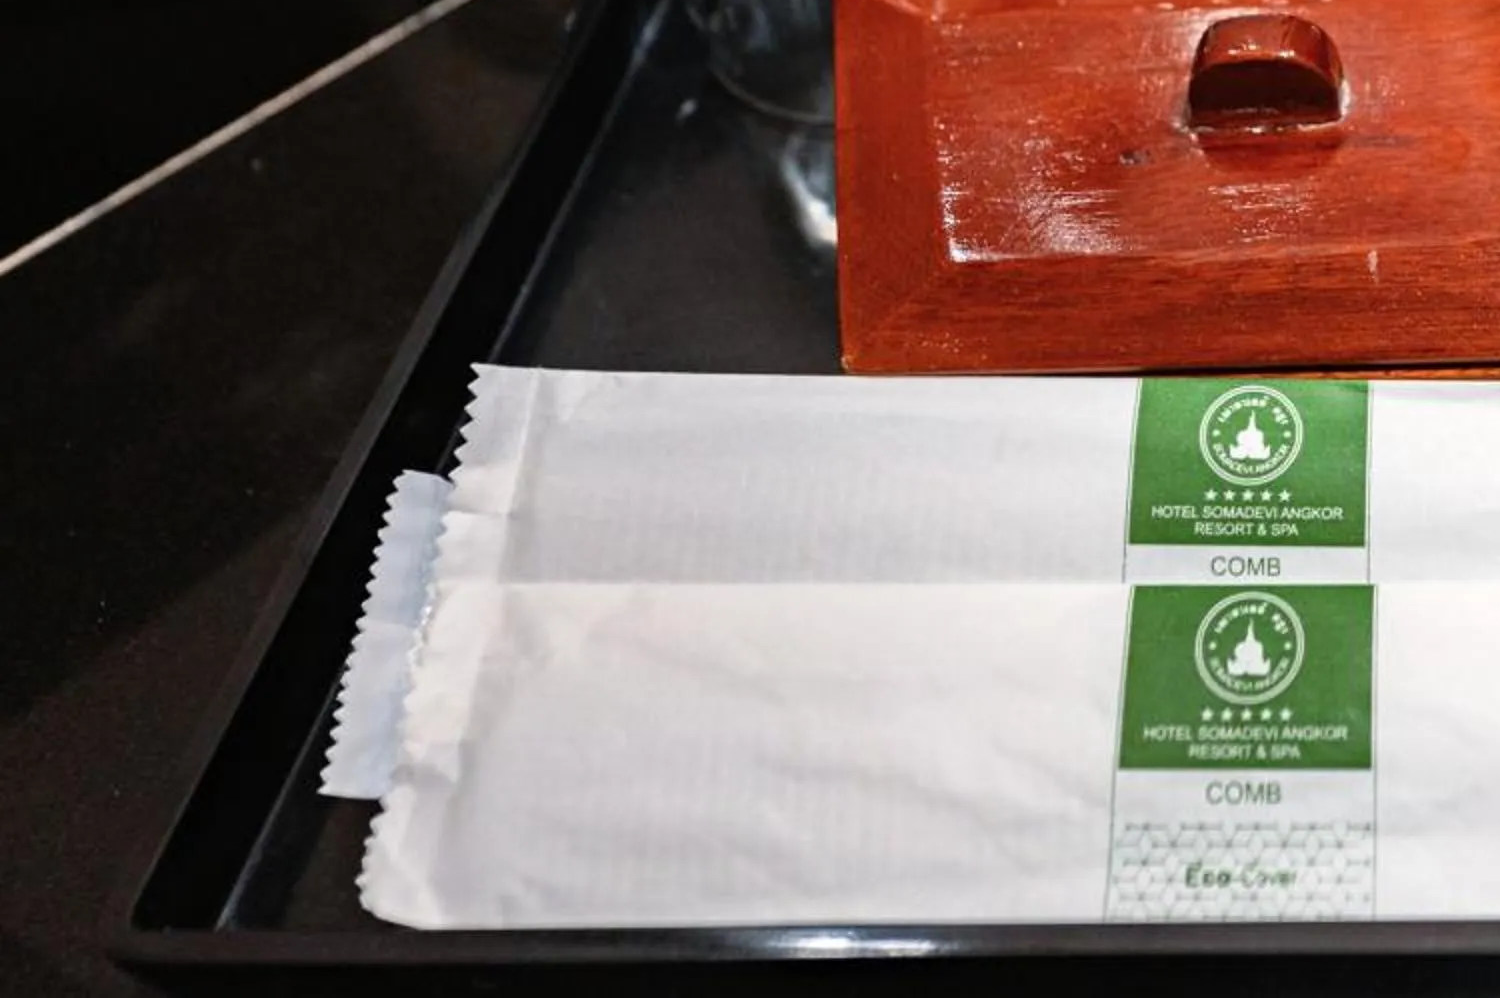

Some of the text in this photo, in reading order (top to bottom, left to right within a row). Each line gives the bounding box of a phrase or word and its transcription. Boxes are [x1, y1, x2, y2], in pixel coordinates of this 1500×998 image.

[1151, 506, 1344, 521] HOTEL SOMADEVI ANGKOR
[1193, 522, 1299, 537] RESORT & SPA
[1210, 555, 1282, 577] COMB
[1143, 725, 1349, 742] HOTEL SOMADEVI ANGKOR
[1188, 744, 1301, 759] RESORT & SPA
[1205, 781, 1282, 805] COMB
[1184, 860, 1232, 889] Eco
